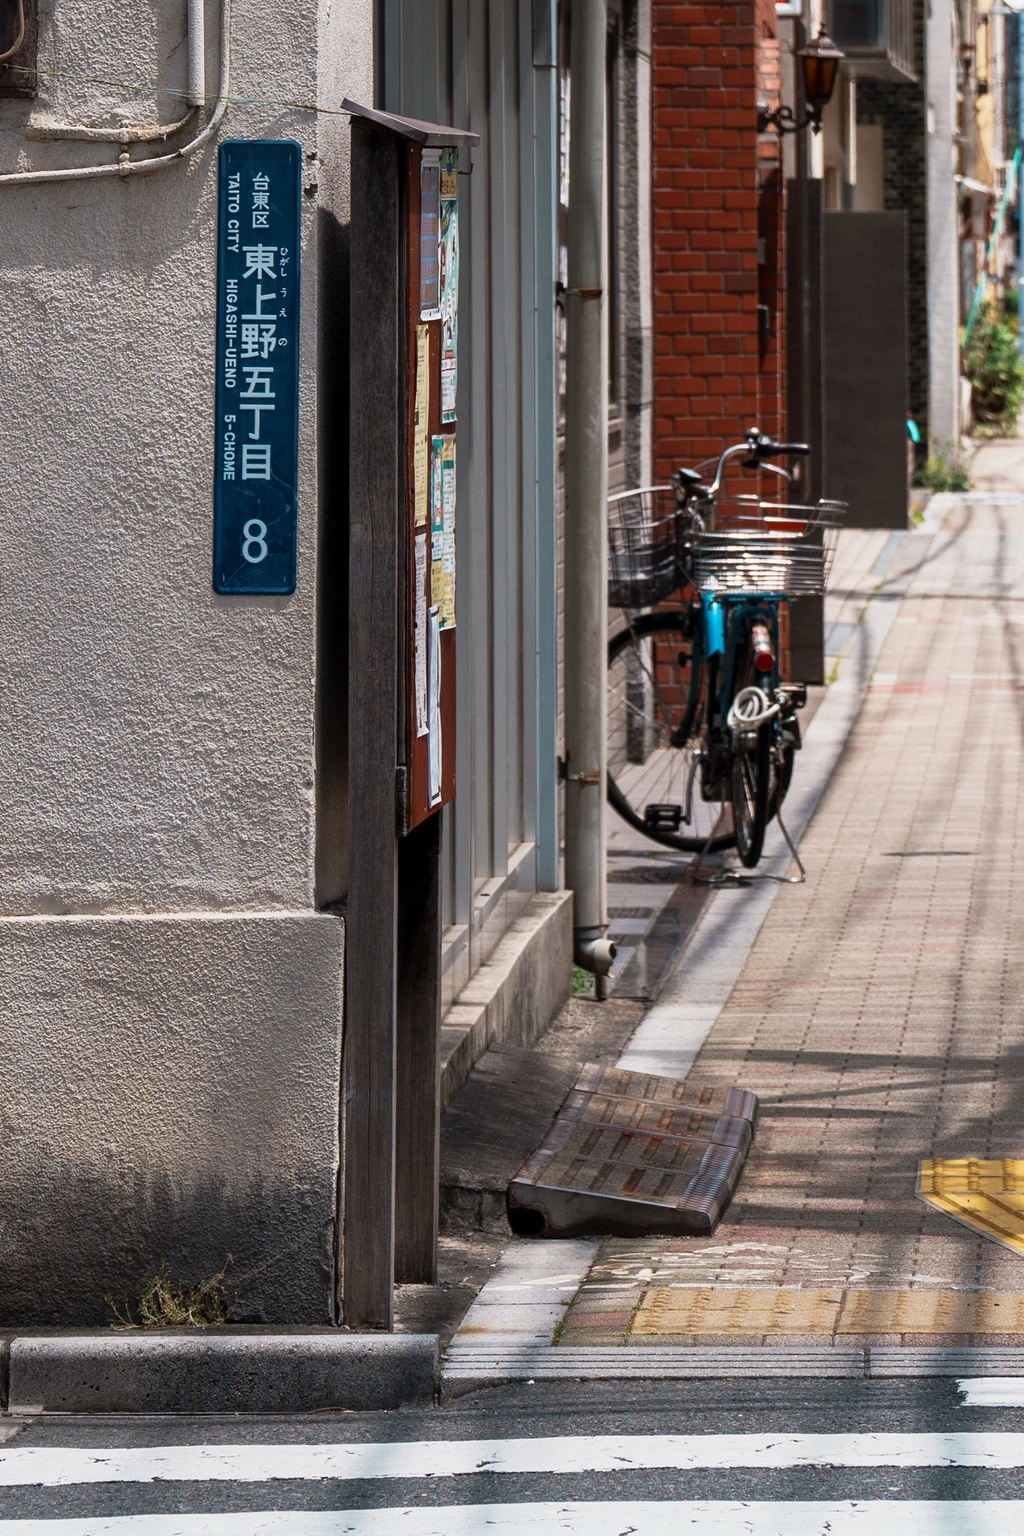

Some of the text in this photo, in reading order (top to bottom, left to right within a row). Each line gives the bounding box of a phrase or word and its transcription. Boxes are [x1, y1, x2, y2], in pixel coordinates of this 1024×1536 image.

[223, 172, 240, 482] TAITO CITY HIGASHI-UENO 5-CHOME
[239, 171, 278, 482] 台東区 東上野五丁目
[241, 518, 268, 564] 8
